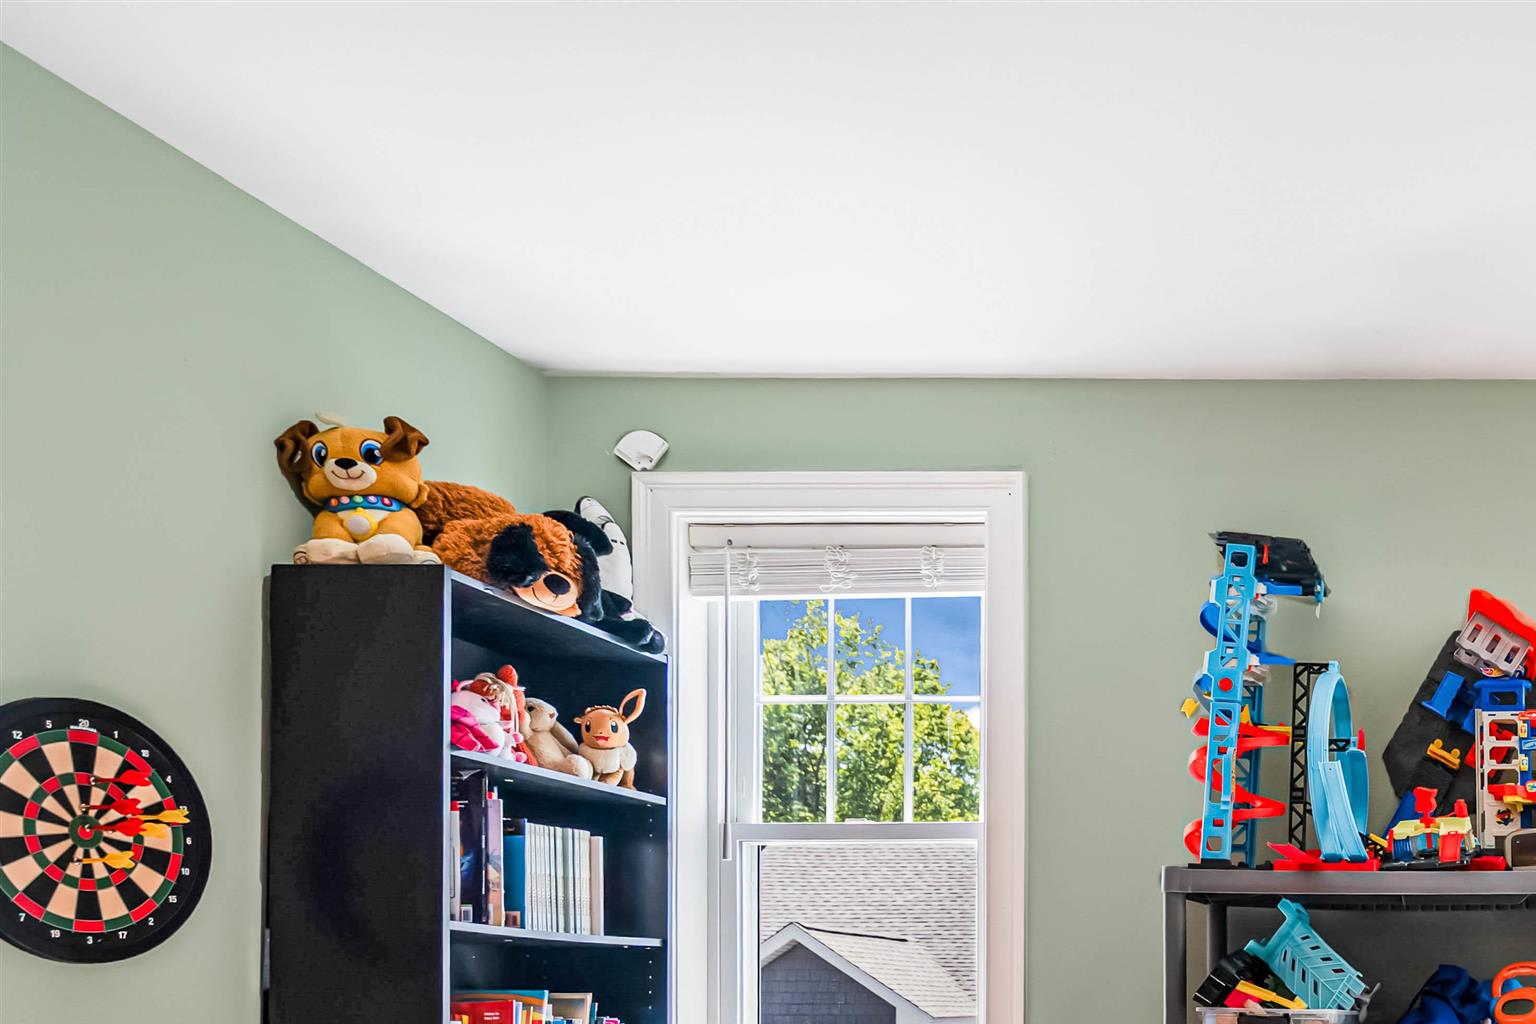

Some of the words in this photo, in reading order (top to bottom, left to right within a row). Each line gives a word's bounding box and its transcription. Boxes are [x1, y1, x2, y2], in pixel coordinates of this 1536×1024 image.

[45, 719, 53, 729] 5
[11, 730, 23, 740] 12
[113, 730, 119, 739] 1
[165, 775, 172, 784] 4
[185, 836, 192, 845] 6
[181, 867, 190, 876] 10
[168, 895, 178, 903] 15
[18, 912, 26, 922] 7
[148, 917, 154, 926] 2
[50, 929, 61, 938] 19
[118, 930, 128, 939] 17
[86, 935, 93, 945] 3
